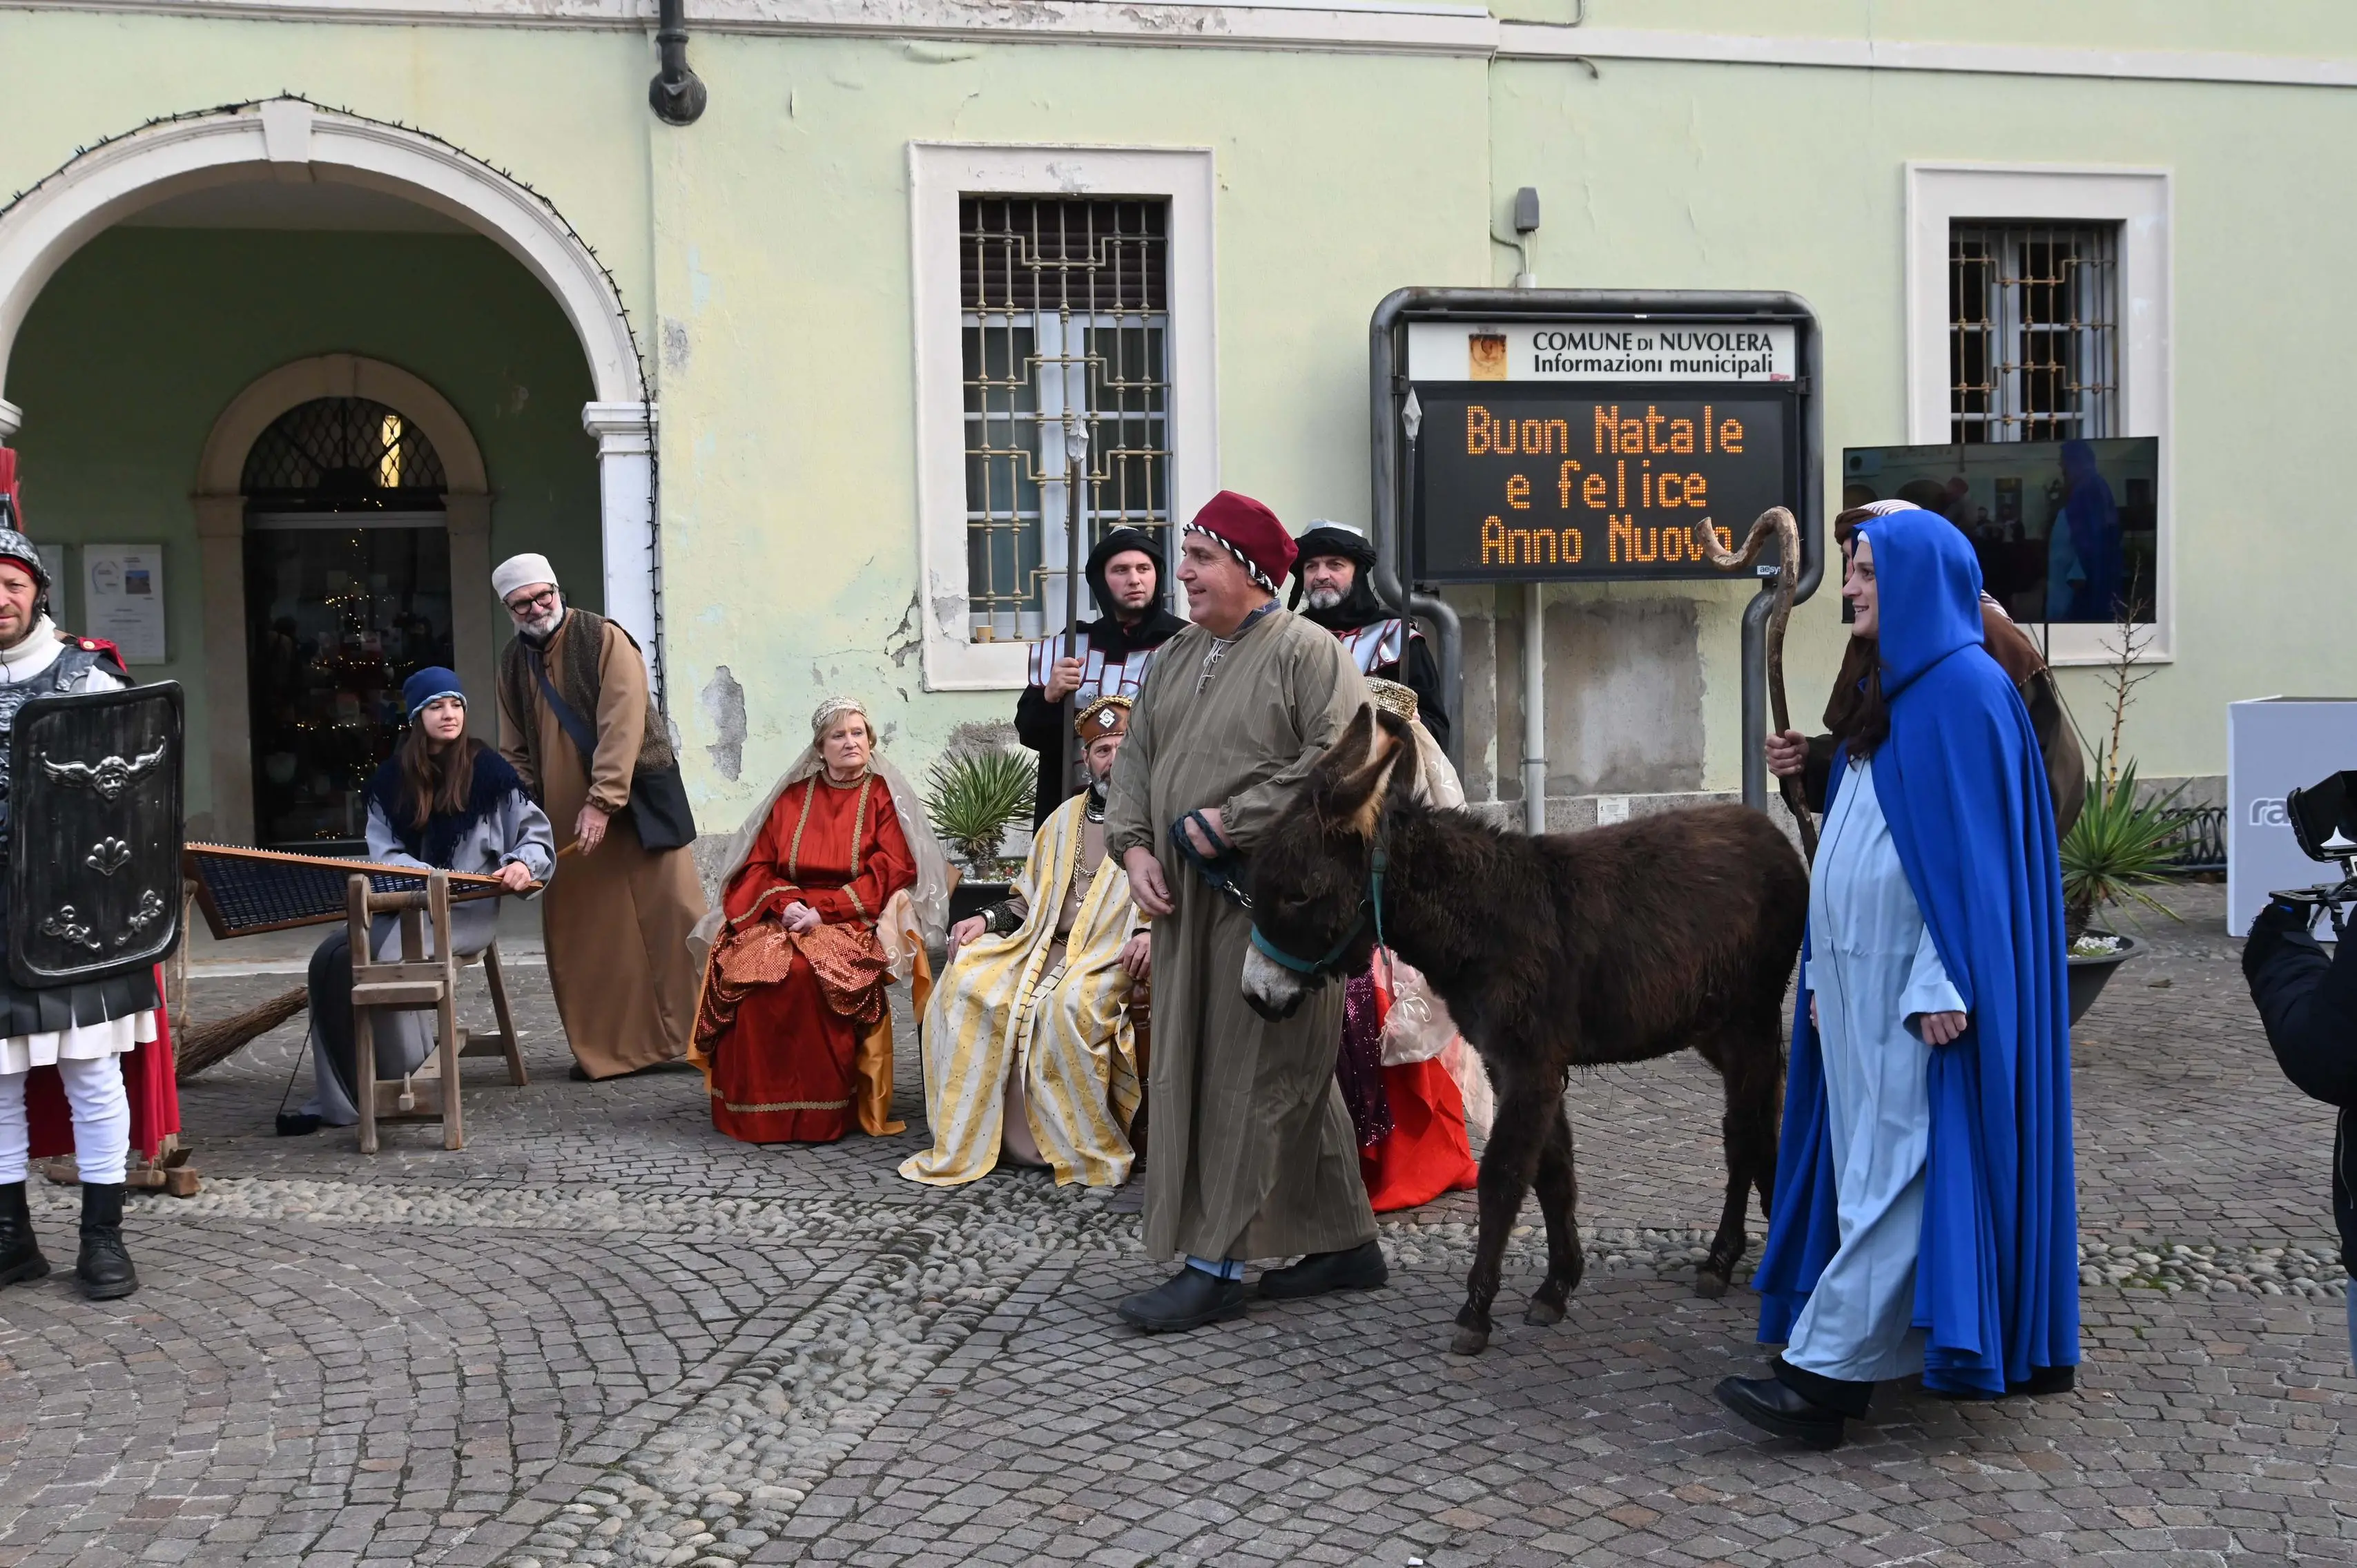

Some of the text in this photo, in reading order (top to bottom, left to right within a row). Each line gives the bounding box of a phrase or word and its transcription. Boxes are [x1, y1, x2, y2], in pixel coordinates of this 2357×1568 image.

[1533, 332, 1773, 351] COMUNE DI NUVOLERA
[1534, 353, 1773, 379] Informazioni municipali
[1467, 405, 1743, 454] Buon Natale
[1506, 459, 1707, 510] e felice
[1482, 515, 1582, 564] Anno
[1760, 565, 1781, 575] aesy
